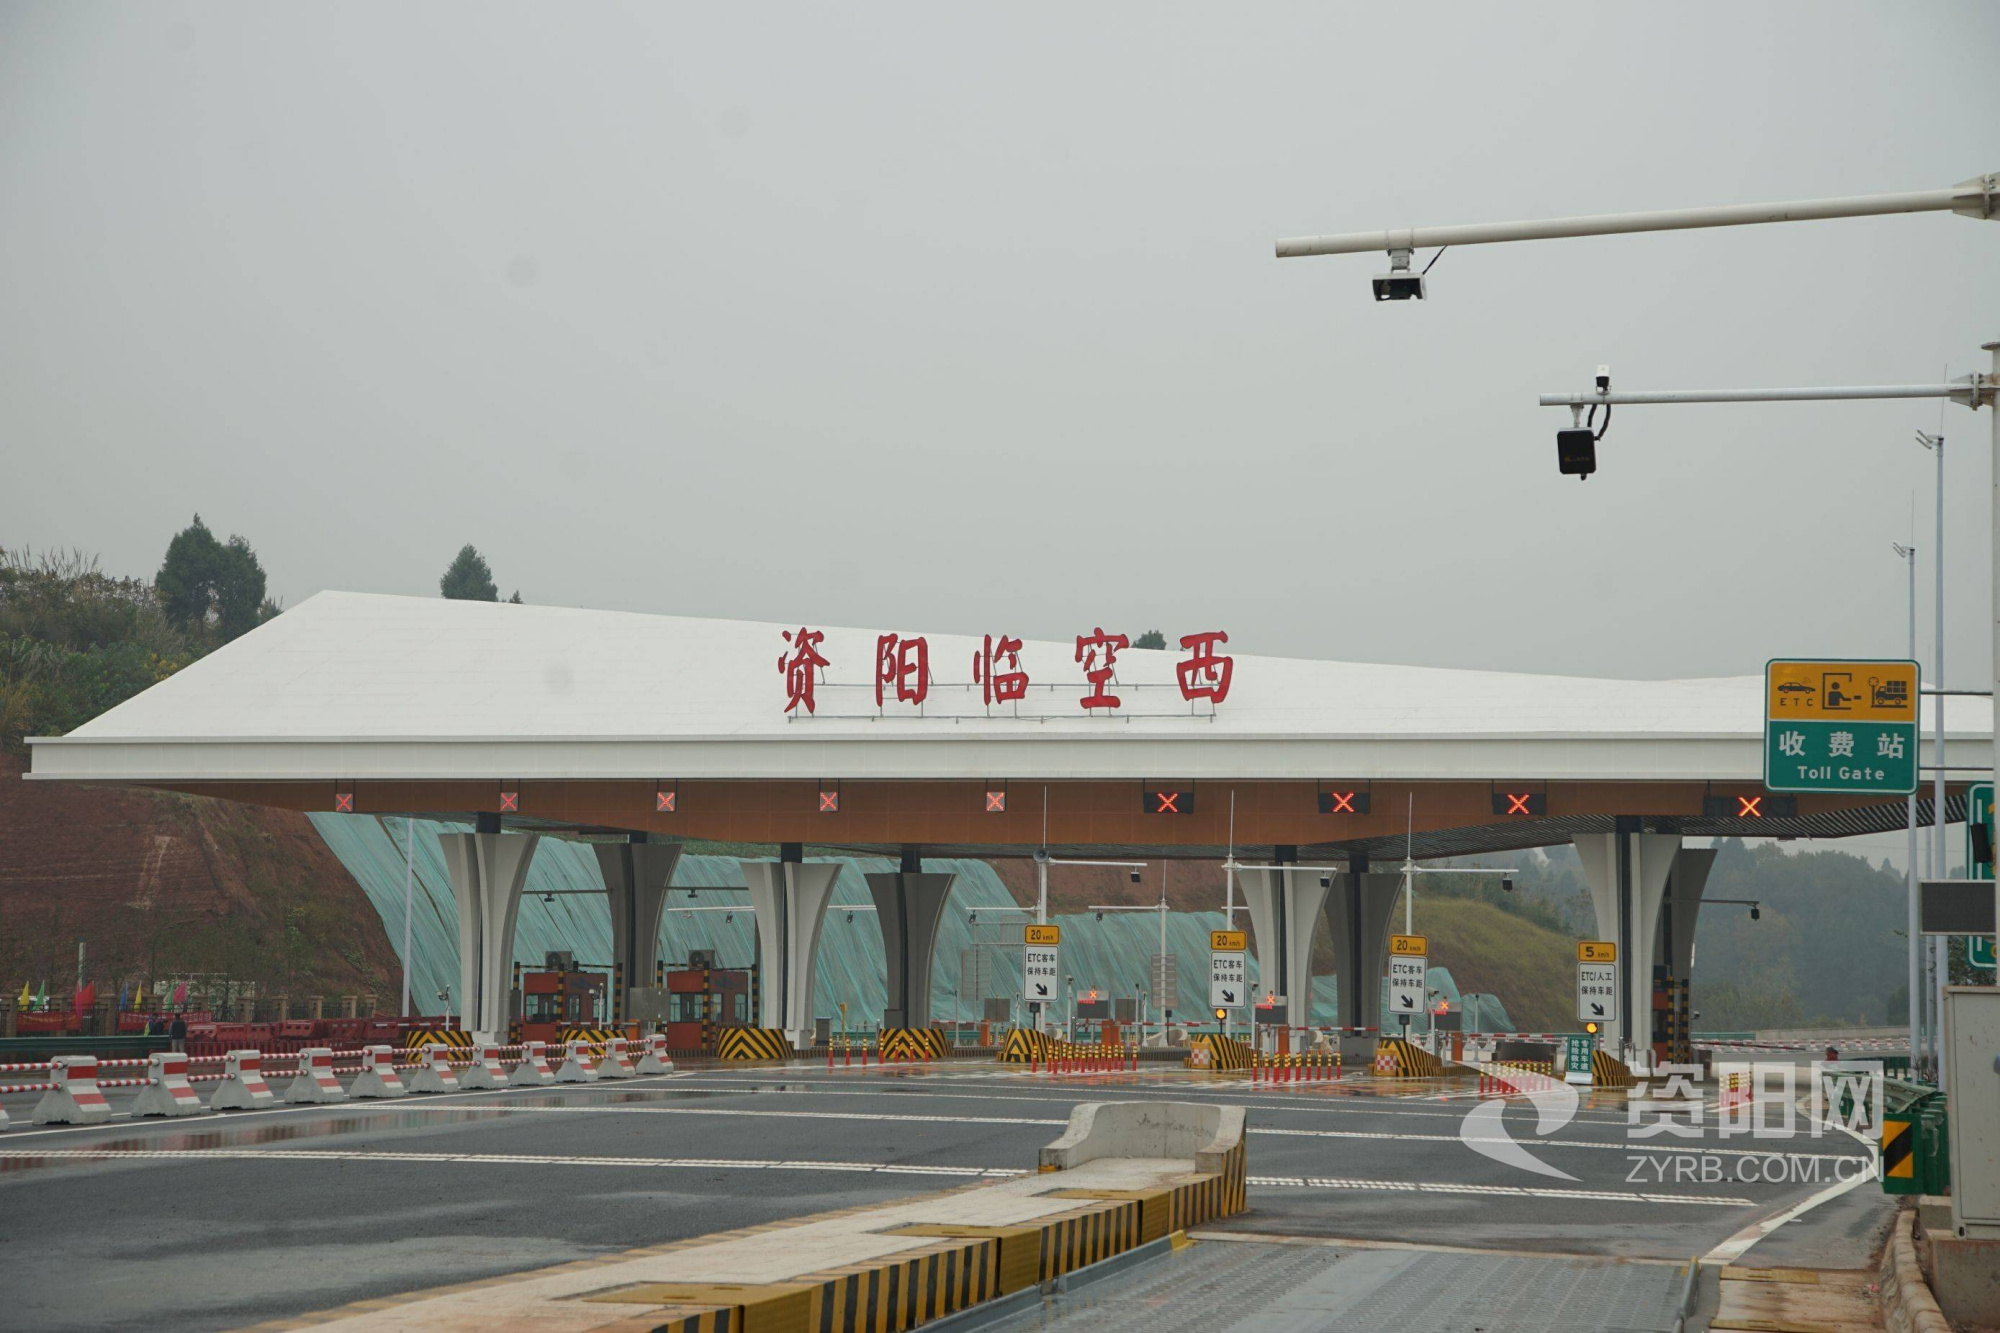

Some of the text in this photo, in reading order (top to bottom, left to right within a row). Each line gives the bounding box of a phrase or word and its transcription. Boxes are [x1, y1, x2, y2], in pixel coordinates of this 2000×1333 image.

[778, 627, 1234, 714] 资阳临空西
[1780, 698, 1813, 706] ETC
[1779, 731, 1905, 759] 收费站
[1797, 766, 1885, 780] Toll Gate
[1030, 930, 1041, 940] 20
[1216, 935, 1228, 946] 20
[1396, 940, 1408, 951] 20
[1585, 946, 1595, 958] 5
[1027, 953, 1056, 963] ETC客车
[1213, 960, 1243, 970] ETC客车
[1392, 964, 1423, 975] ETC客车
[1027, 967, 1056, 976] 保持车距
[1581, 971, 1613, 982] ETC/人工
[1213, 973, 1243, 983] 保持车距
[1392, 978, 1423, 989] 保持车距
[1581, 985, 1613, 996] 保持车距
[1580, 1040, 1589, 1071] 专用车道
